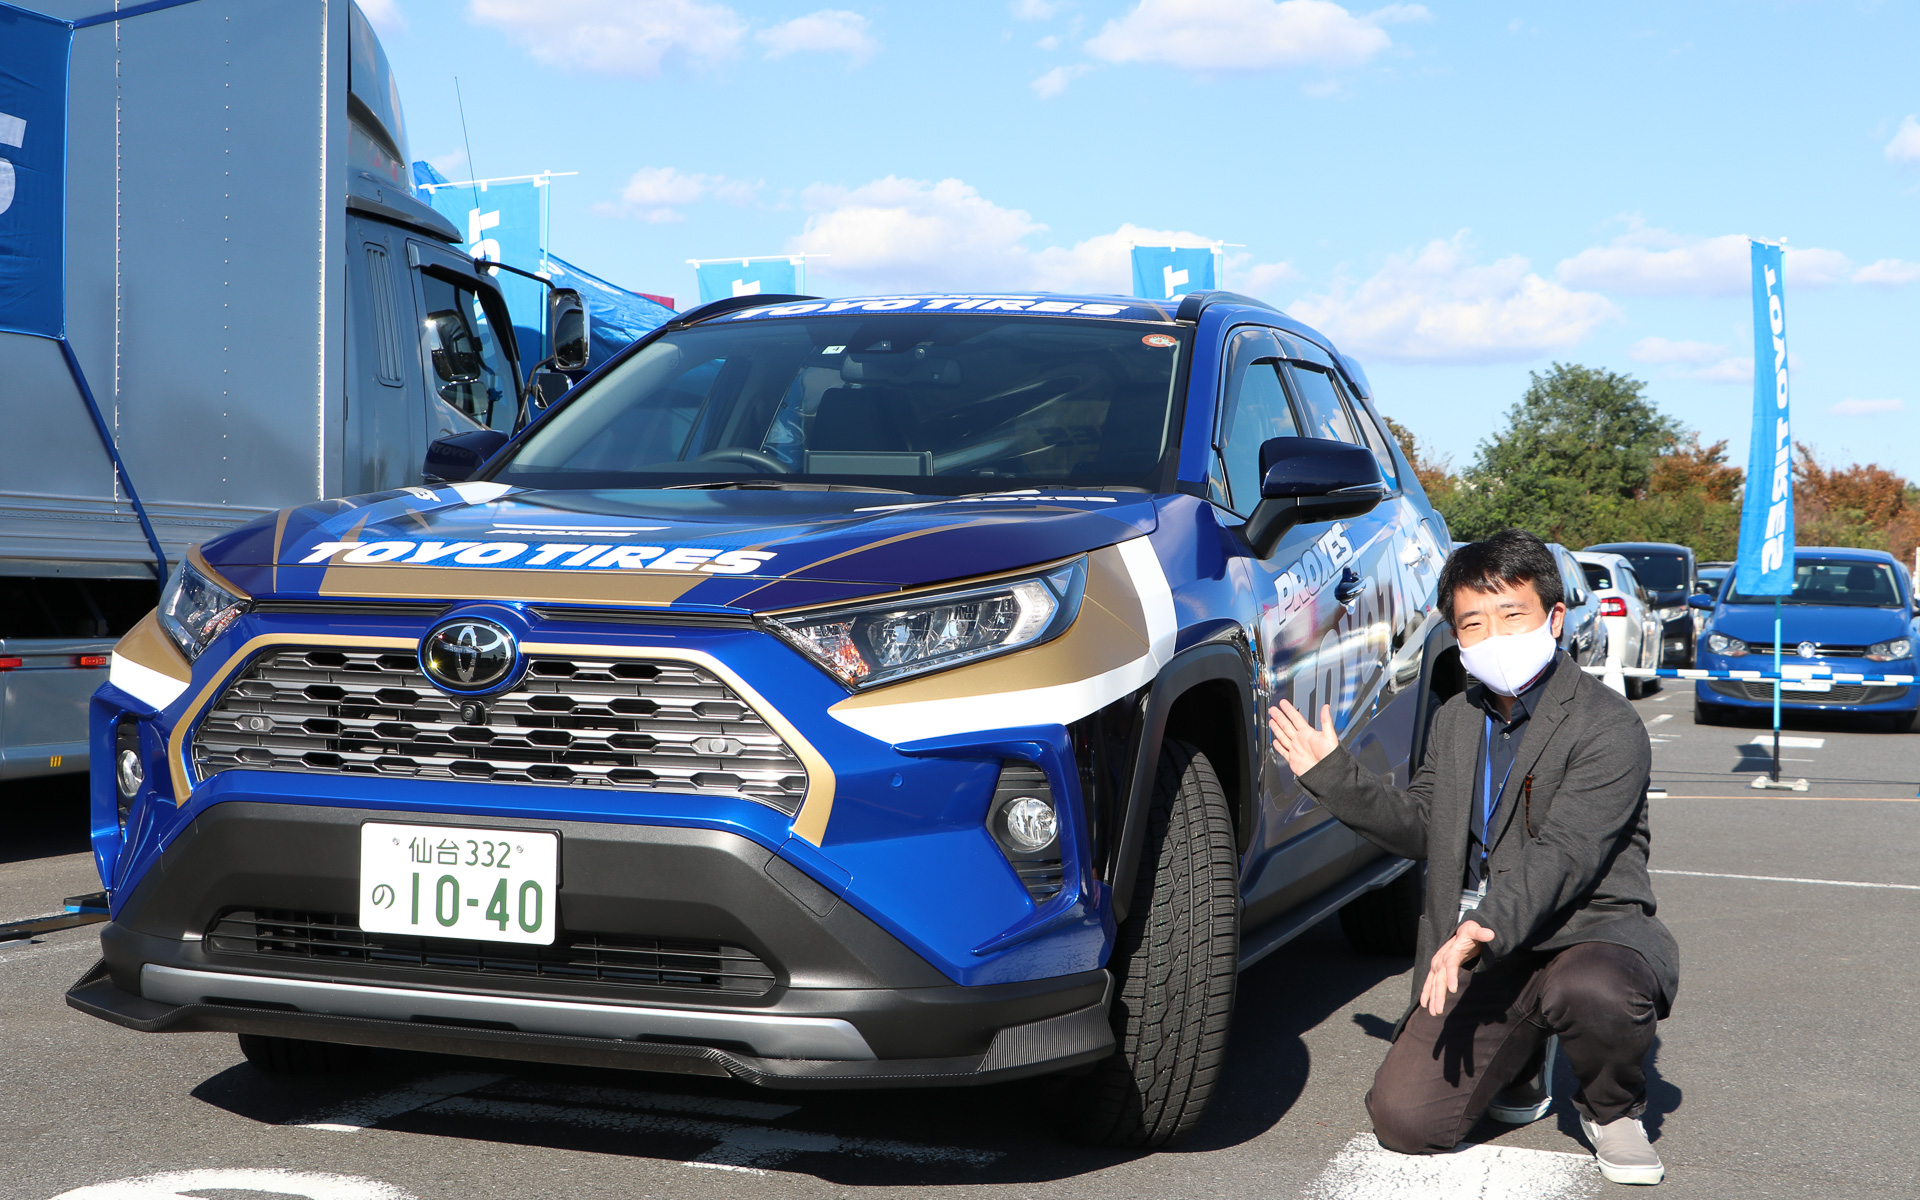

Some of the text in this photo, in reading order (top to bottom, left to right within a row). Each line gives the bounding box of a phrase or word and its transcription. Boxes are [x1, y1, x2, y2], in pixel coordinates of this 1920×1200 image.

[732, 299, 1130, 319] TOYO TIRES
[1761, 264, 1789, 575] TOYO TIRES
[299, 541, 778, 573] TOYO TIRES
[1273, 521, 1354, 626] PROXES
[372, 872, 543, 933] の 10-40
